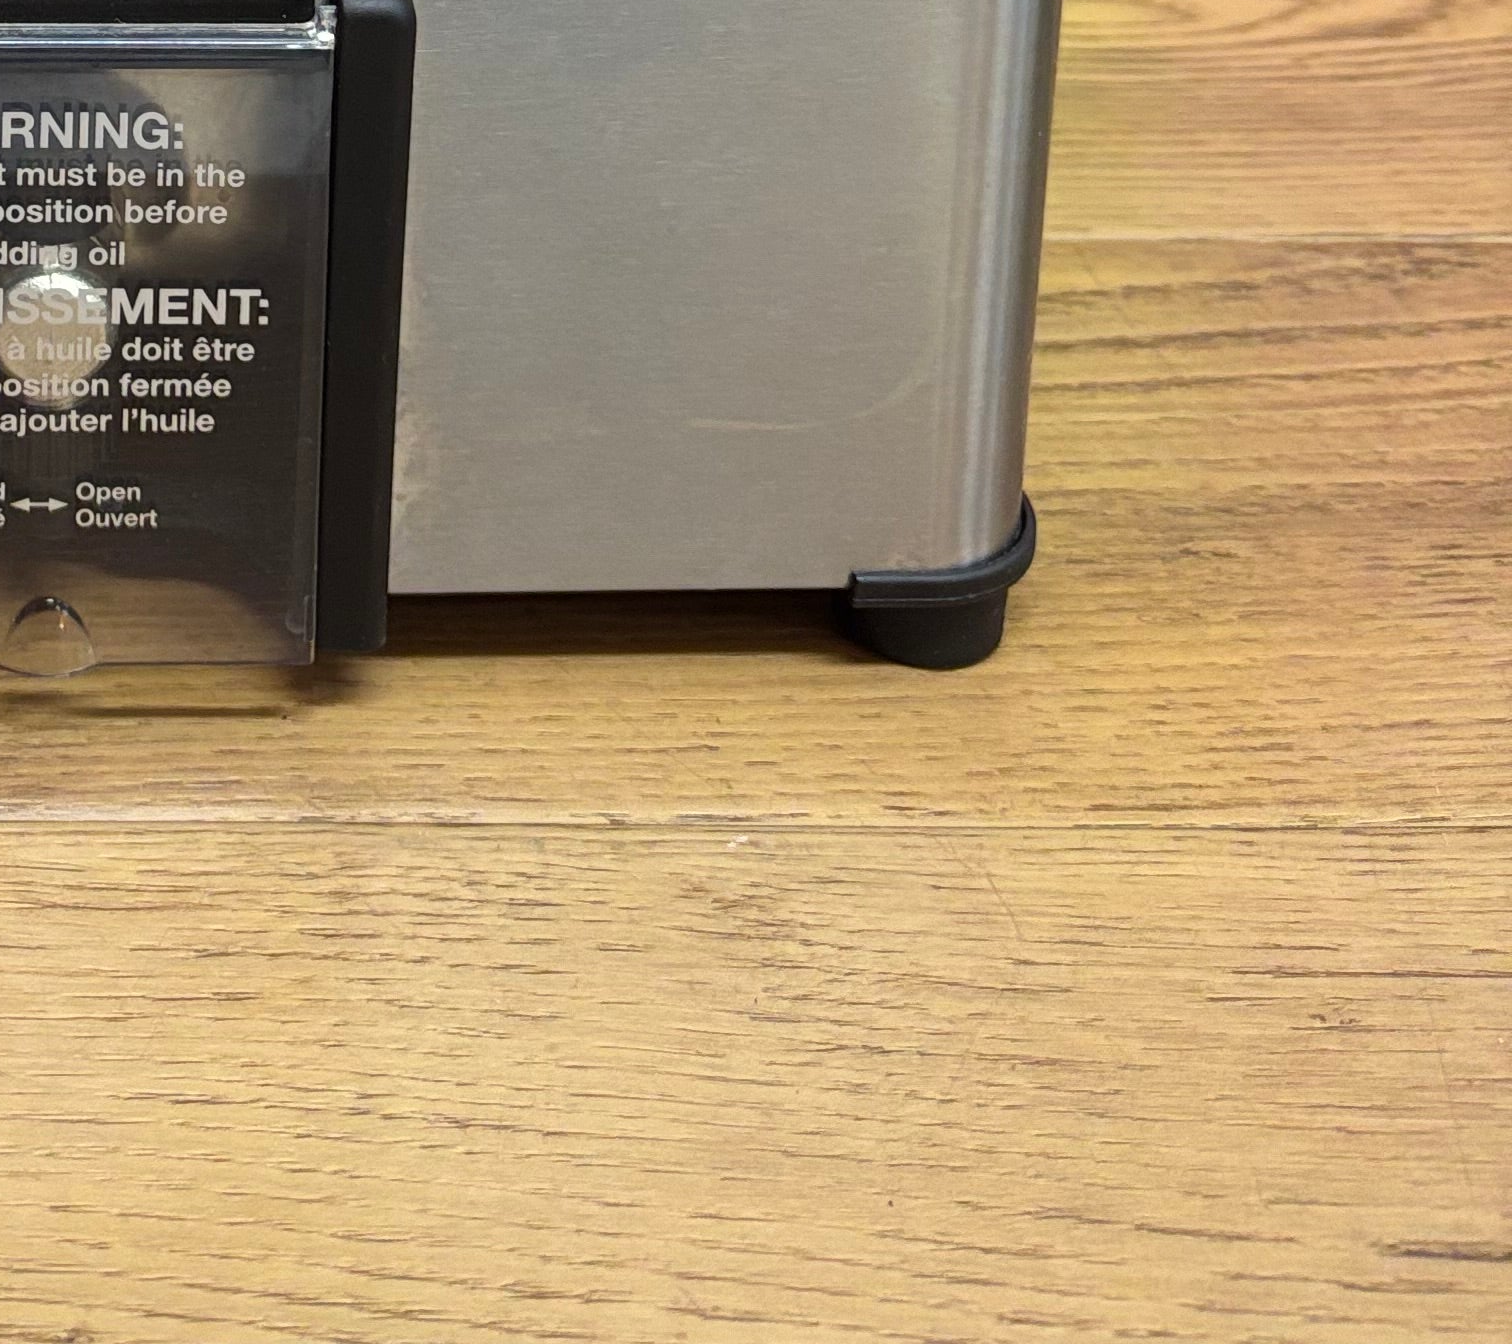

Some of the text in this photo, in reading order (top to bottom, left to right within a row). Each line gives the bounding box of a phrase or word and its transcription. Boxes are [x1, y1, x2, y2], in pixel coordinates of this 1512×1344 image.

[16, 166, 97, 187] must
[107, 162, 146, 187] be
[156, 162, 184, 187] in
[194, 163, 246, 188] the
[124, 199, 228, 225] before
[88, 241, 126, 266] oil
[6, 335, 26, 361] à
[36, 336, 112, 362] huile
[121, 336, 184, 362] doit
[192, 336, 256, 362] être
[119, 373, 232, 398] fermée
[75, 481, 142, 506] Open
[74, 508, 159, 529] Ouvert
